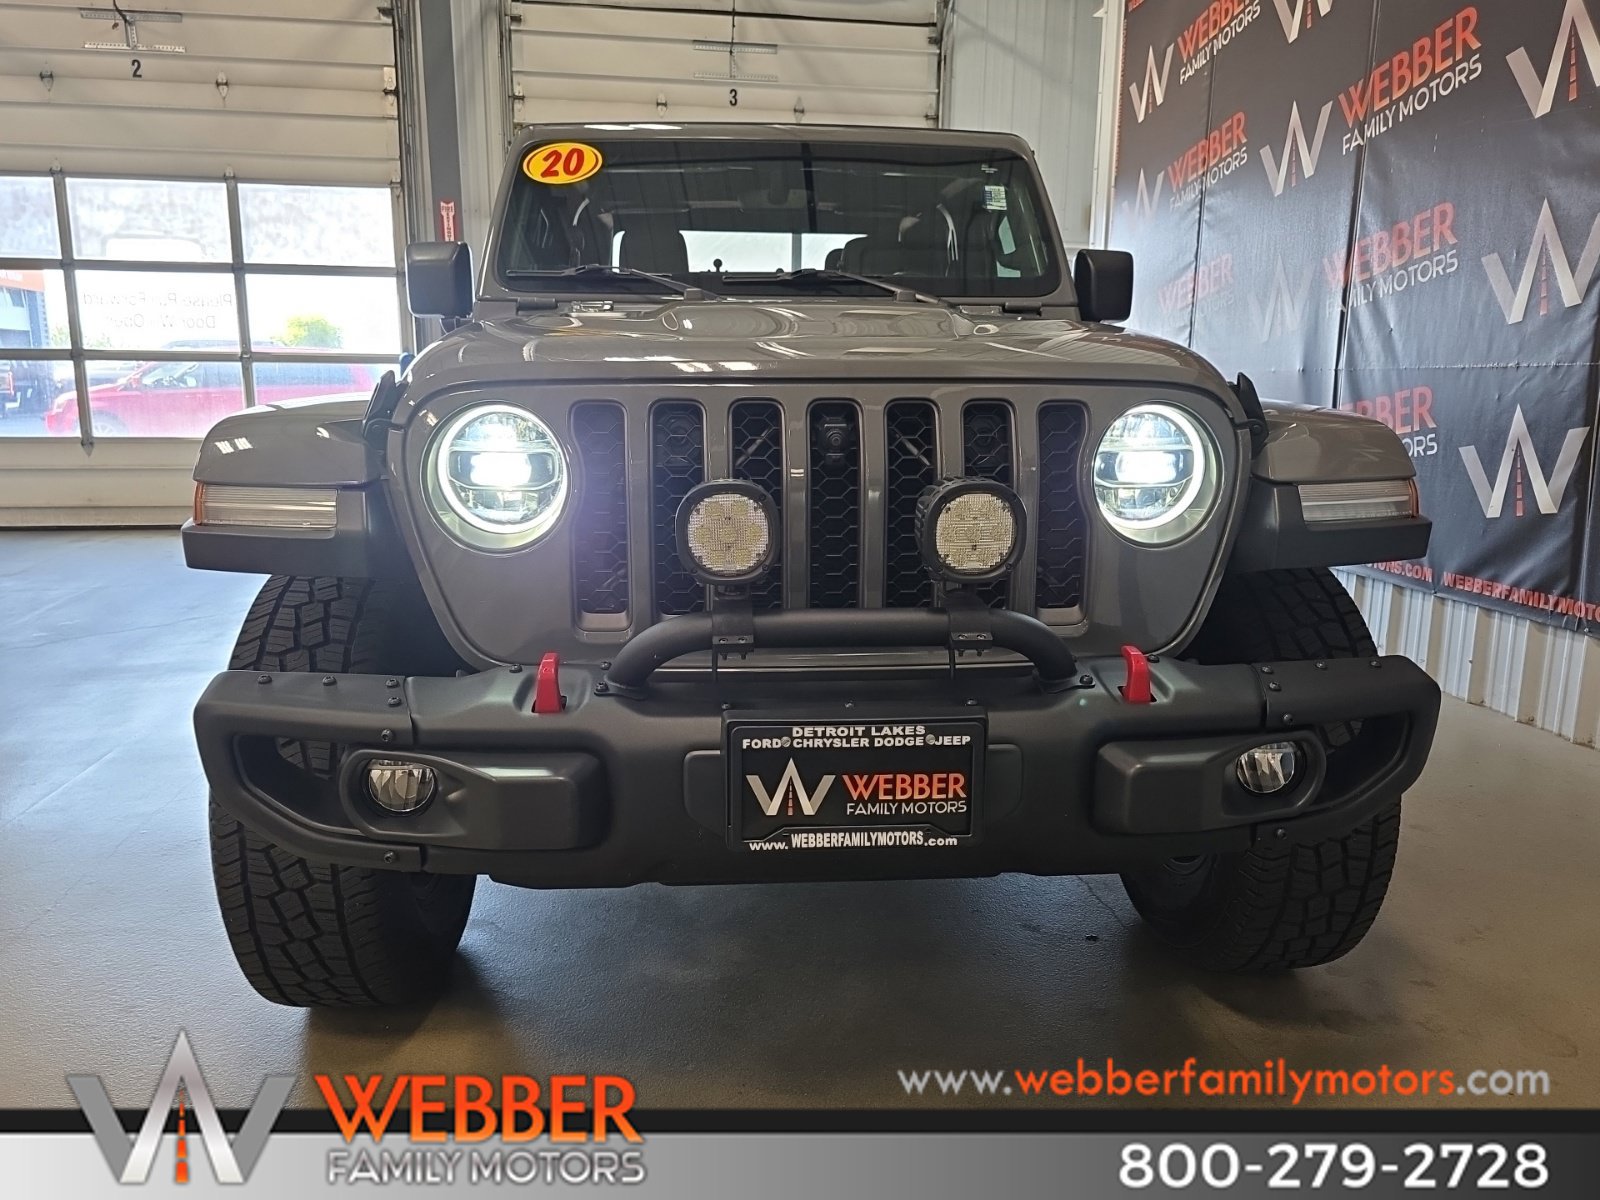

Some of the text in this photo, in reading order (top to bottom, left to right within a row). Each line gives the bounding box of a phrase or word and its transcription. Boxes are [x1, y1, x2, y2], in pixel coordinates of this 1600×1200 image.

[1177, 0, 1249, 64] WEBBE
[1180, 0, 1260, 85] FAMILY MOTORS
[131, 59, 142, 78] 2
[1338, 6, 1482, 128] WEBBER
[729, 88, 738, 107] 3
[1342, 53, 1482, 156] FAMILY MOTORS
[540, 147, 585, 178] 20
[1167, 111, 1248, 193] WEBBER
[1203, 147, 1248, 190] MOTORS
[1322, 202, 1458, 289] WEBBER
[1379, 250, 1459, 299] MOTORS
[1401, 433, 1438, 457] ORS
[742, 735, 971, 749] FORD CHRYSLER DODGE JEEP
[792, 725, 926, 738] DETROIT LAKES
[842, 773, 967, 800] WEBBER
[847, 800, 967, 815] FAMILY MOTORS
